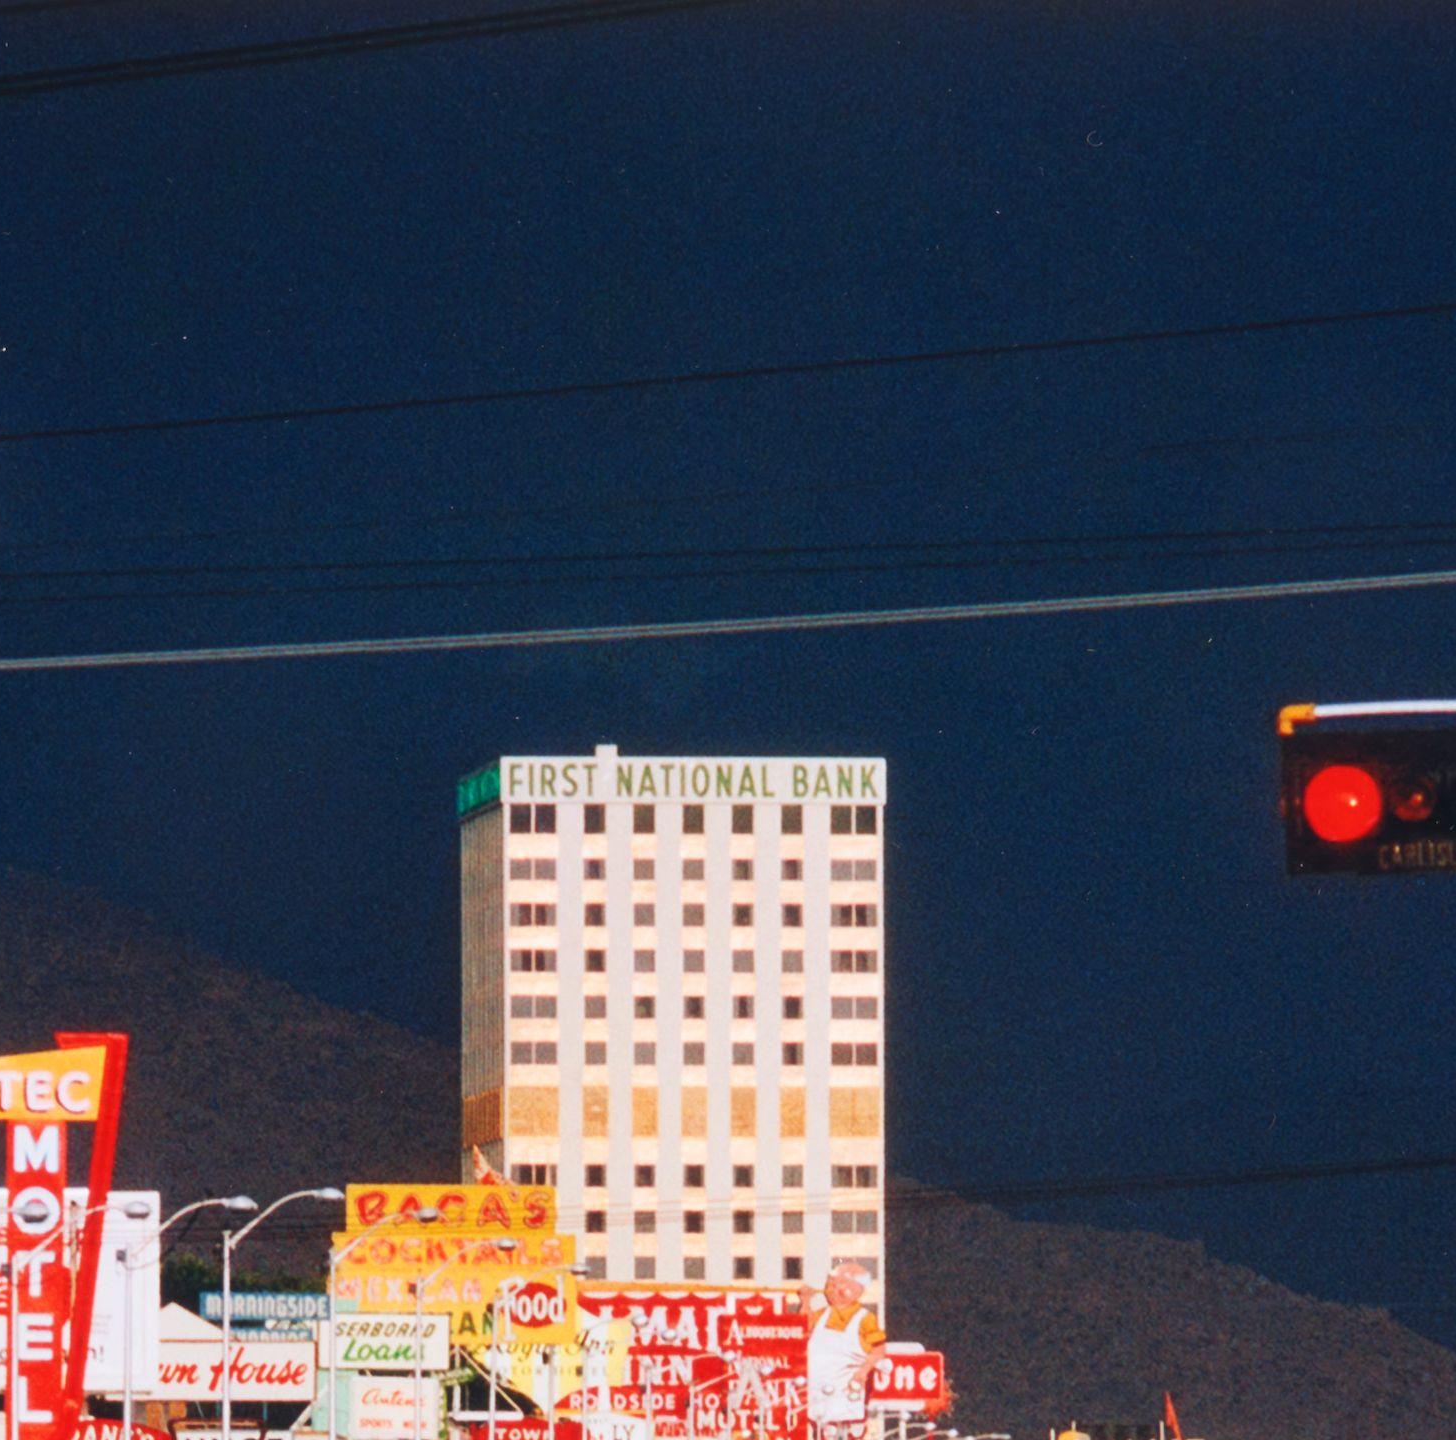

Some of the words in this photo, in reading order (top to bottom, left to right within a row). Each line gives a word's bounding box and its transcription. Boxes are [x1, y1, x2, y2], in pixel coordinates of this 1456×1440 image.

[508, 763, 598, 798] FIRST
[615, 763, 775, 798] NATIONAL
[791, 765, 880, 799] BANK
[569, 1393, 677, 1410] RODSIDE
